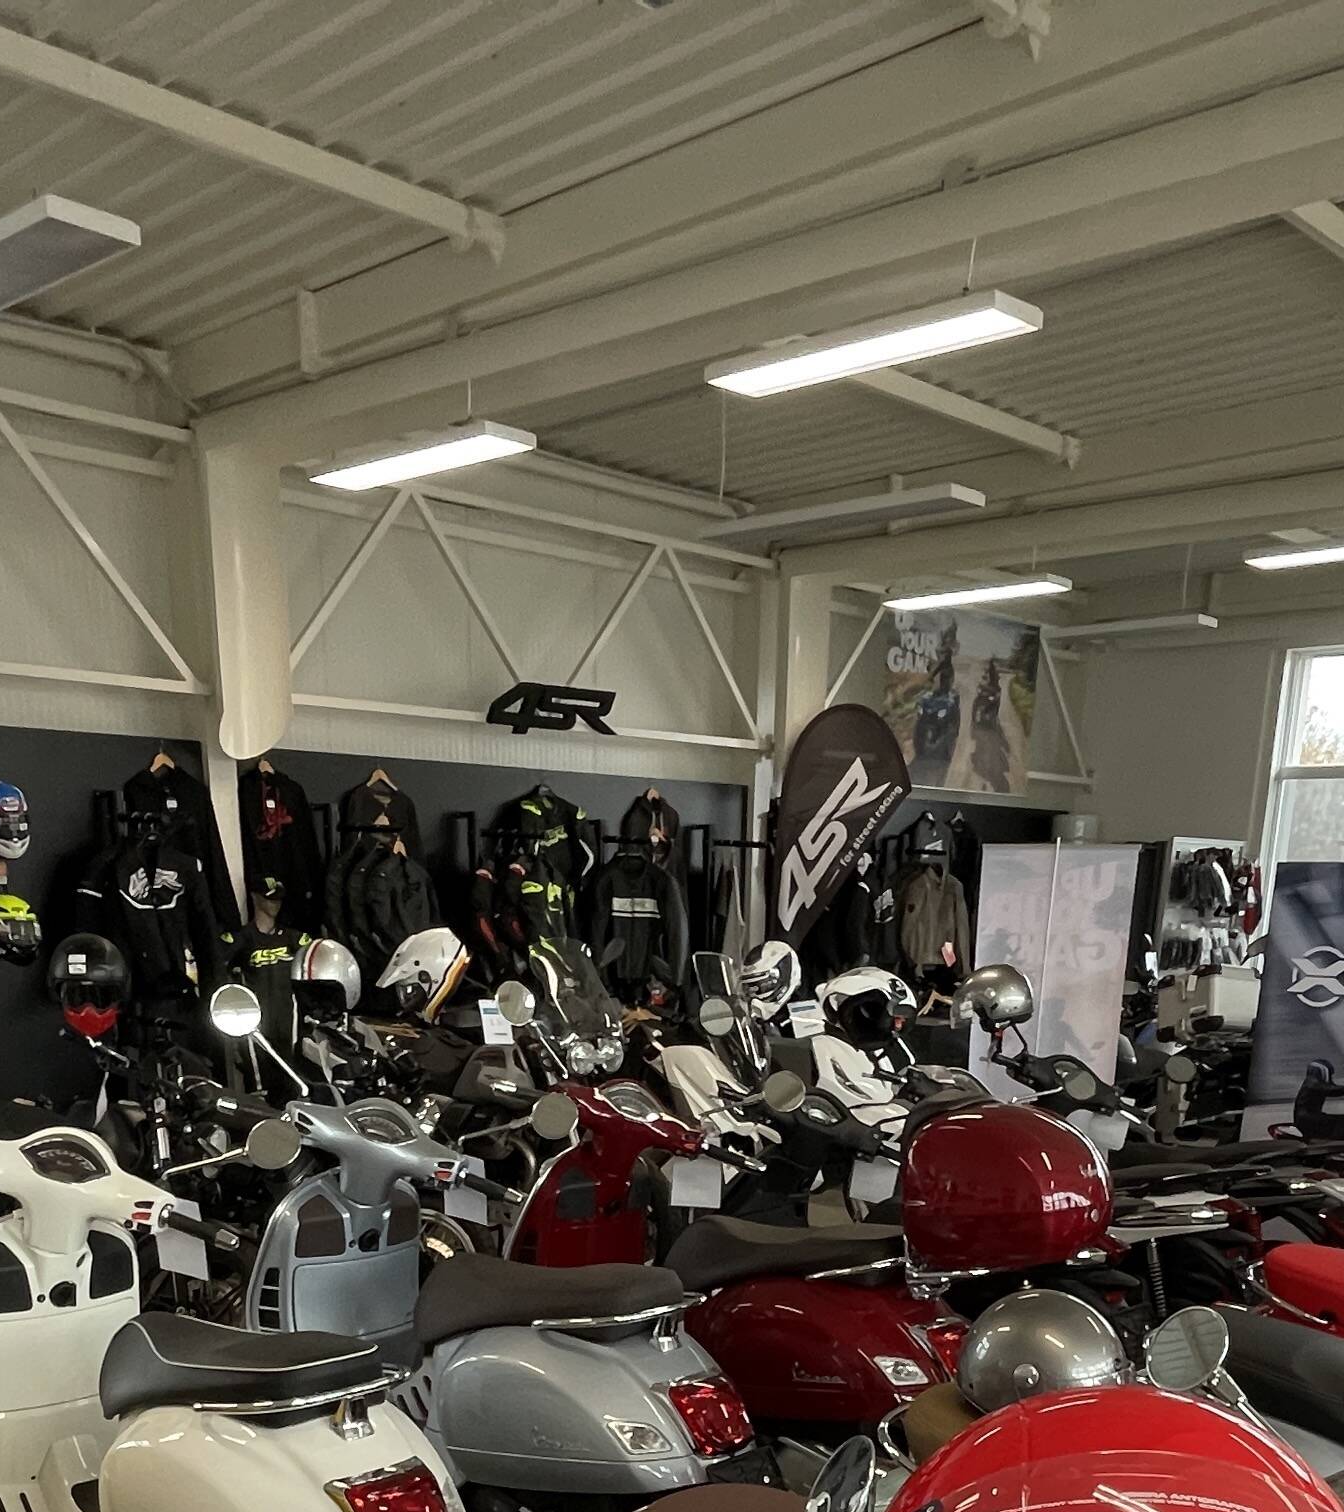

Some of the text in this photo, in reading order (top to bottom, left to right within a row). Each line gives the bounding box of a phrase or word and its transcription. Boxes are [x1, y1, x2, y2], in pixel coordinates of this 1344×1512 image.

[486, 682, 618, 735] 4SR
[778, 756, 892, 932] 4SR
[853, 816, 878, 851] street
[875, 785, 904, 819] racing
